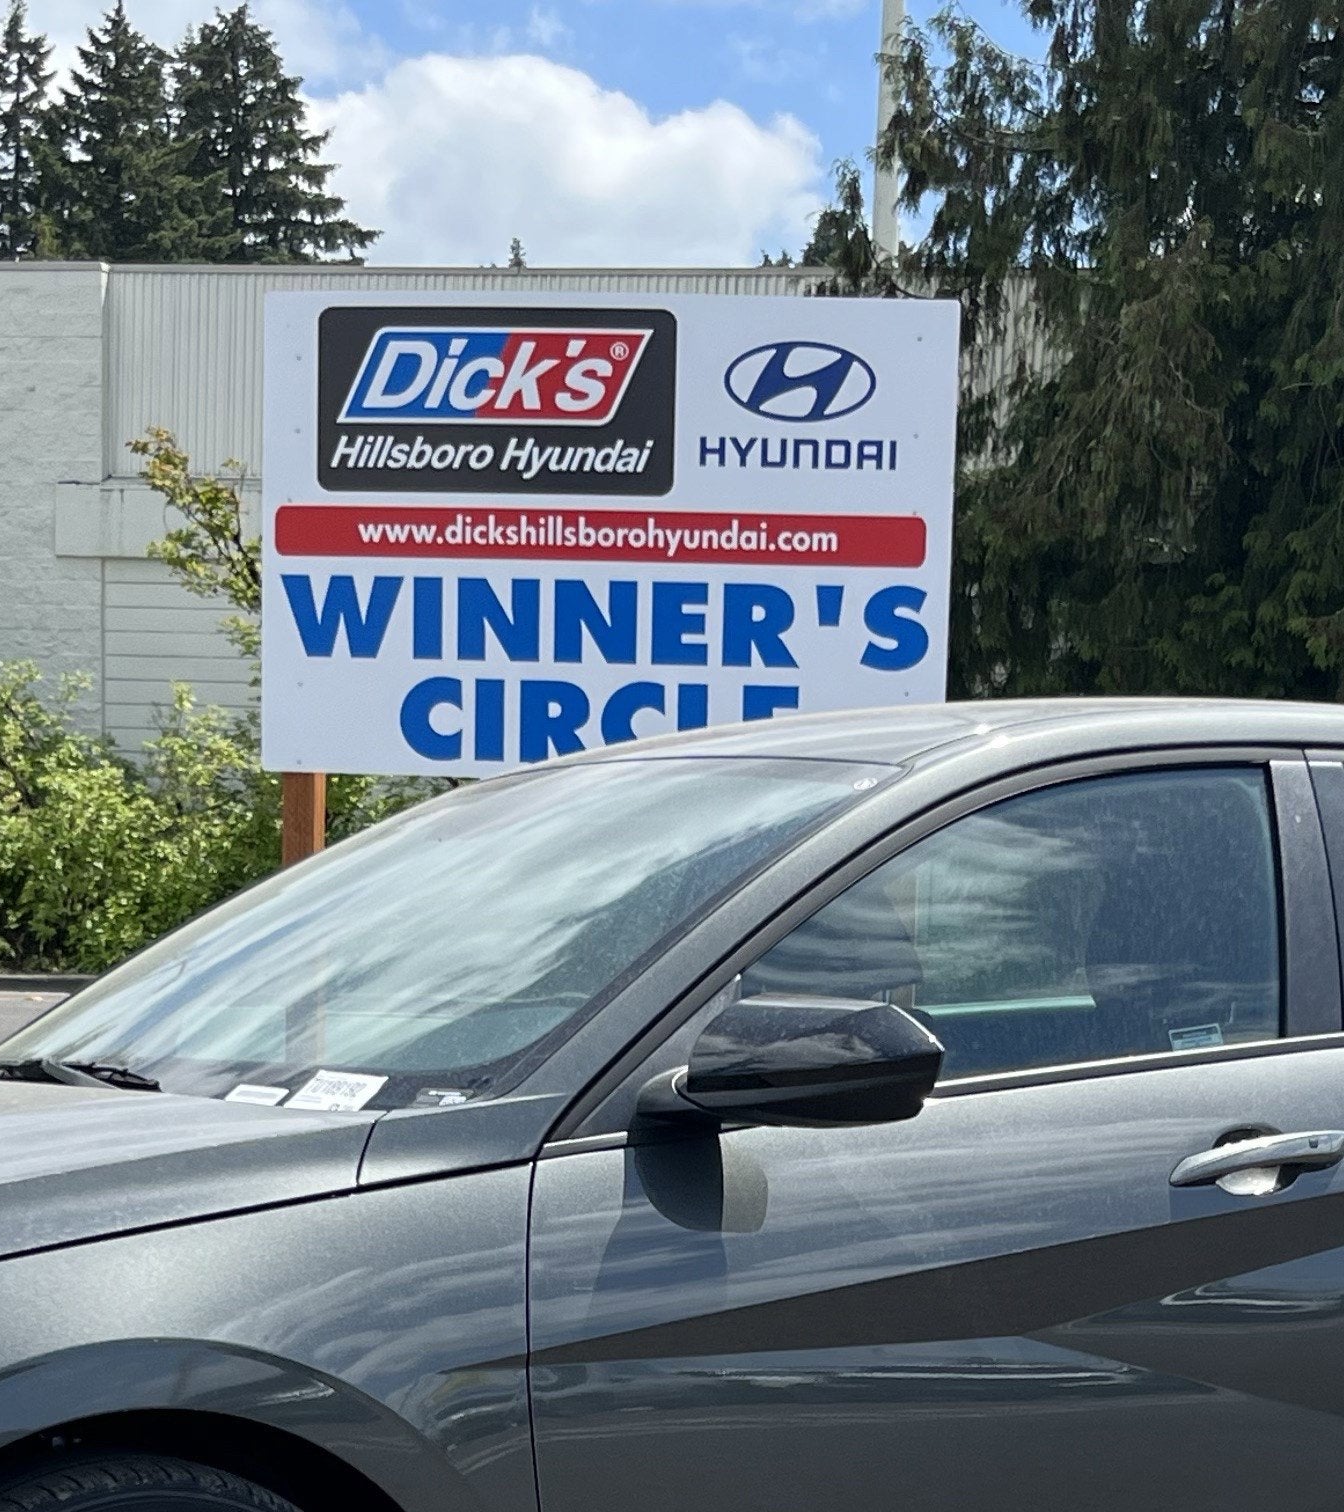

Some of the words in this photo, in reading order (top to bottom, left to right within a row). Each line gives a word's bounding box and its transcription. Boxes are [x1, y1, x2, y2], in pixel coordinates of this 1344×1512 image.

[362, 338, 614, 413] Dick's
[330, 435, 494, 473] Hillsboro
[499, 438, 654, 480] Hyundai
[698, 436, 897, 471] HYUNDAI
[357, 514, 839, 557] www.dickshillsborohyundai.com
[282, 573, 930, 671] WINNER'S
